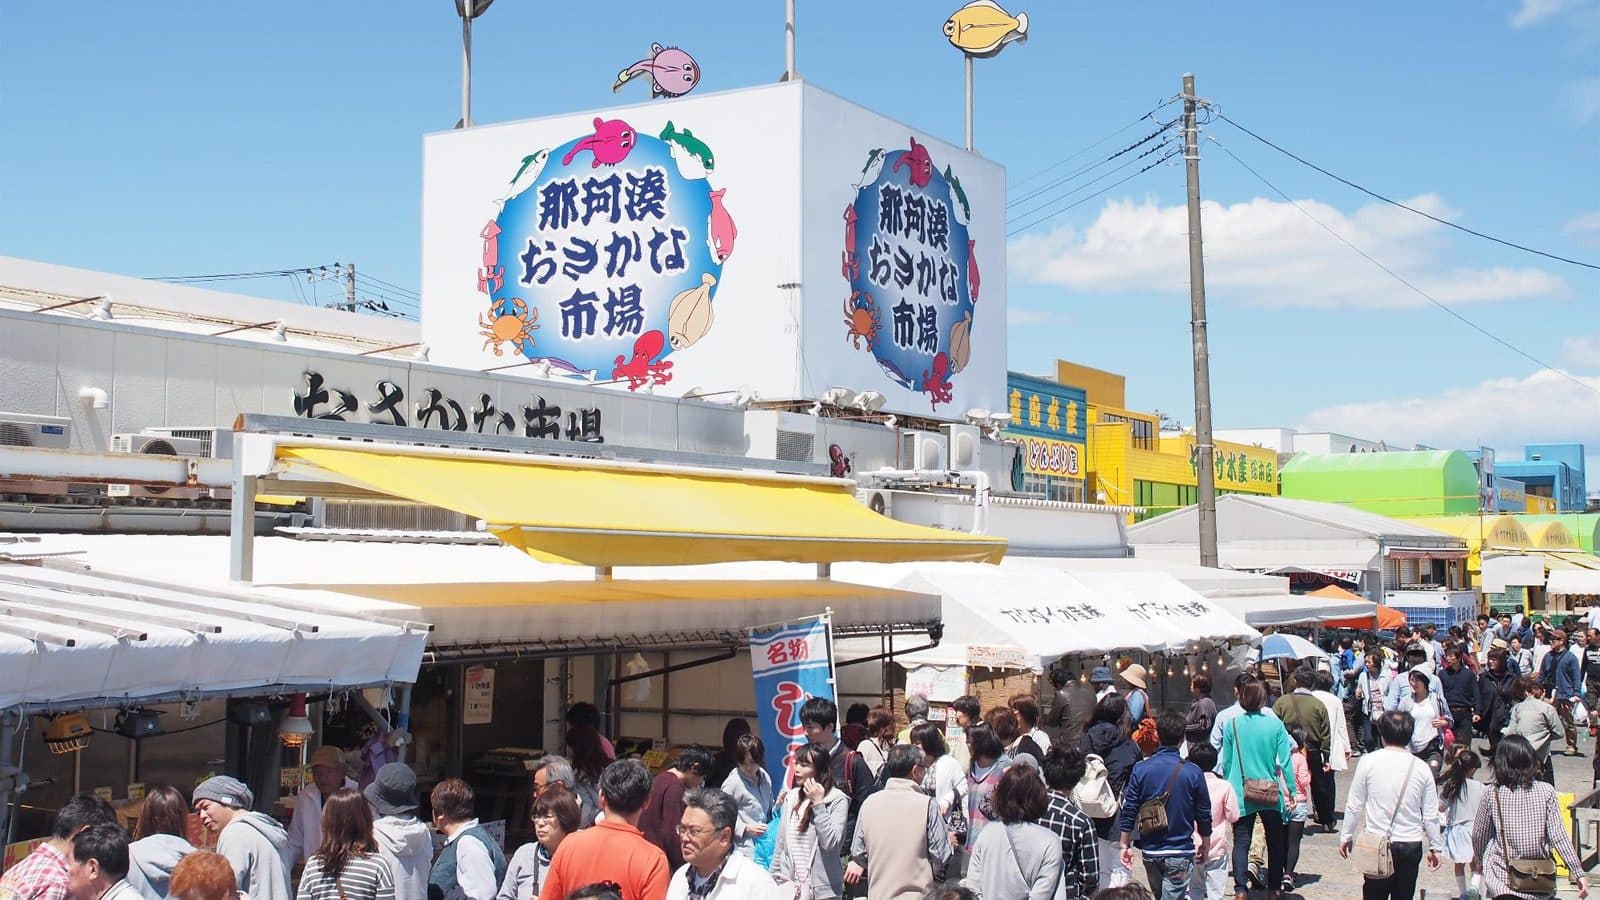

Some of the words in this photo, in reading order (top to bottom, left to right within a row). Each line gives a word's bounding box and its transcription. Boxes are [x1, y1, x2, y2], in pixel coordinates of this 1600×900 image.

[539, 169, 667, 231] 那珂湊
[879, 184, 949, 252] 那珂湊
[521, 226, 687, 285] おさかな
[869, 236, 959, 302] おさかな
[559, 283, 645, 339] 市場
[892, 297, 939, 354] 市場
[767, 638, 809, 665] 名物
